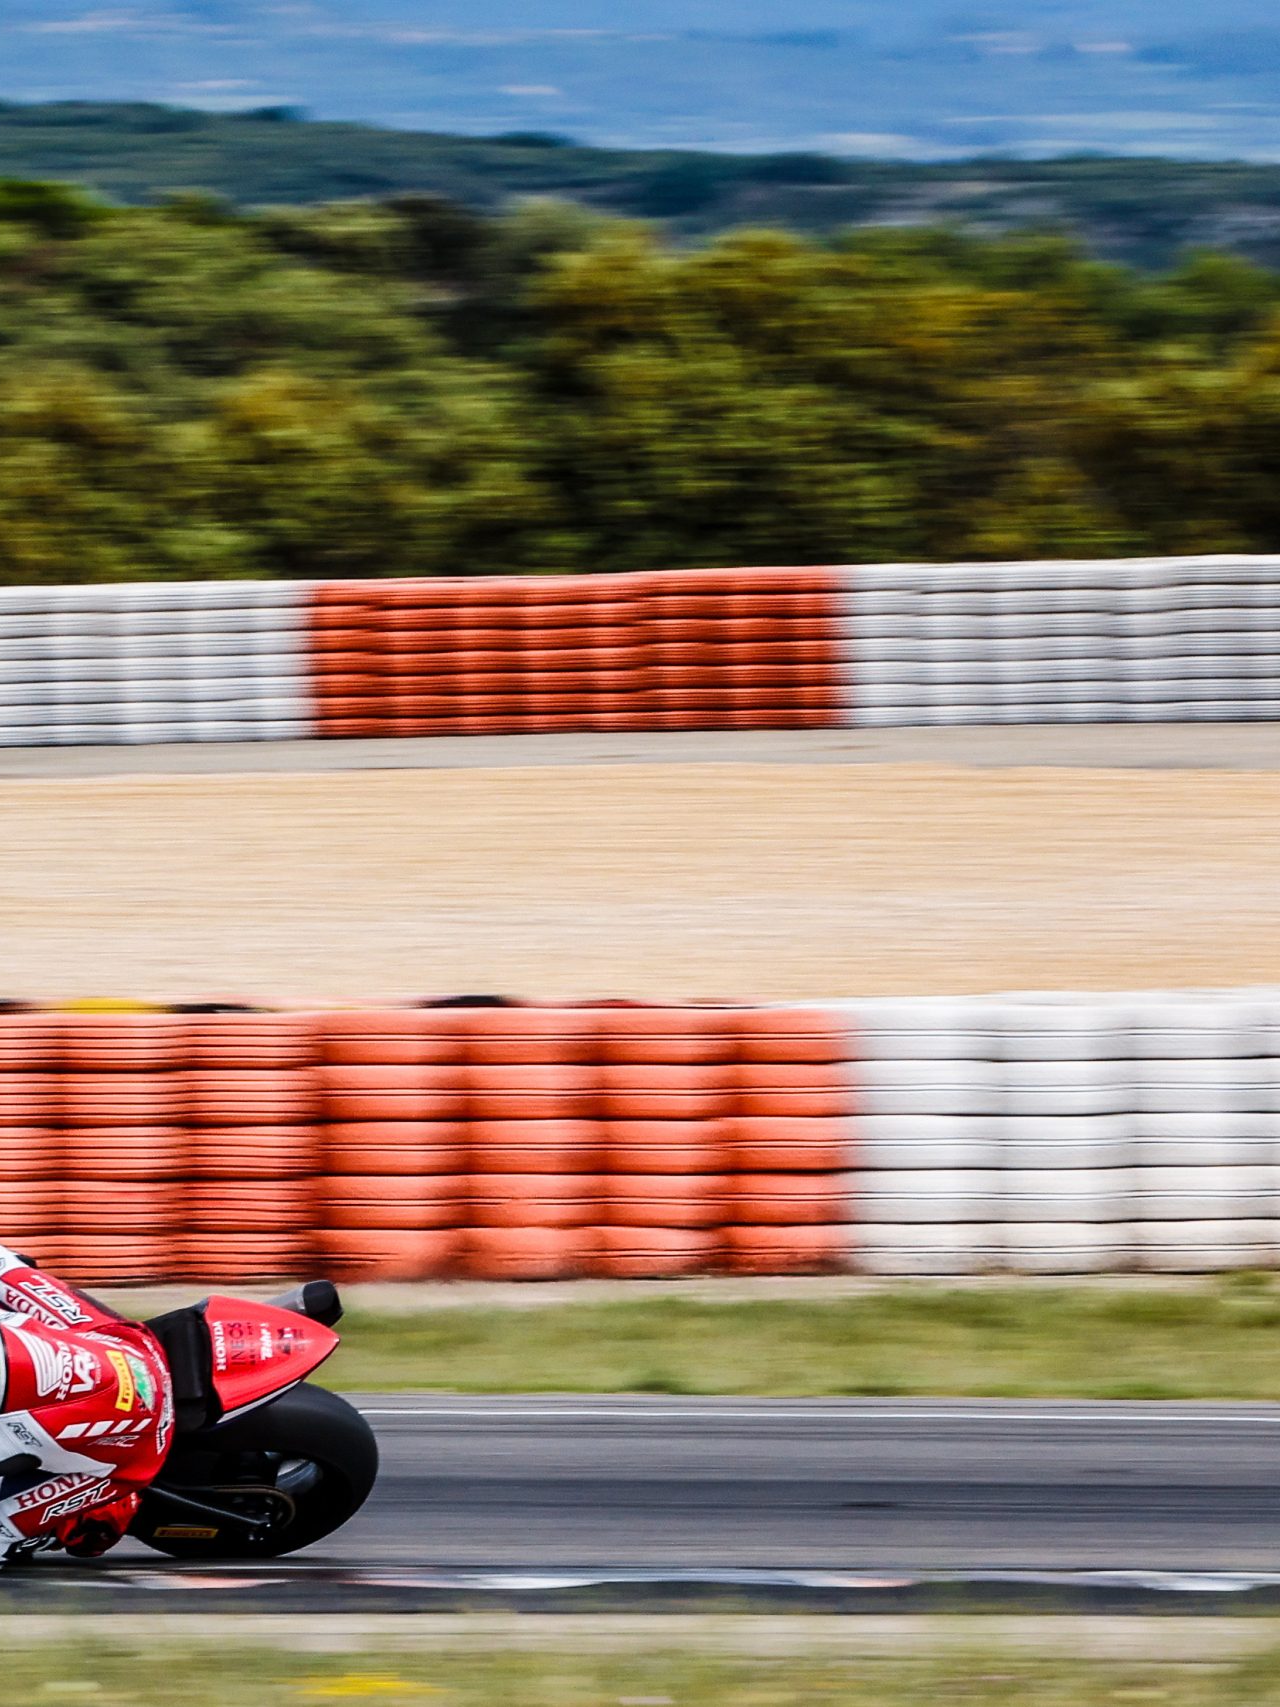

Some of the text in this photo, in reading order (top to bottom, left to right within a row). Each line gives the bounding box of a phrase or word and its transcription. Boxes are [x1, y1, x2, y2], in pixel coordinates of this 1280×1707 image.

[5, 1287, 65, 1328] ONDA
[18, 1275, 93, 1325] RST
[212, 1321, 227, 1371] HONDA
[227, 1322, 246, 1366] INEOS
[53, 1341, 73, 1400] HOND
[15, 1473, 93, 1508] HON
[39, 1479, 117, 1525] RST
